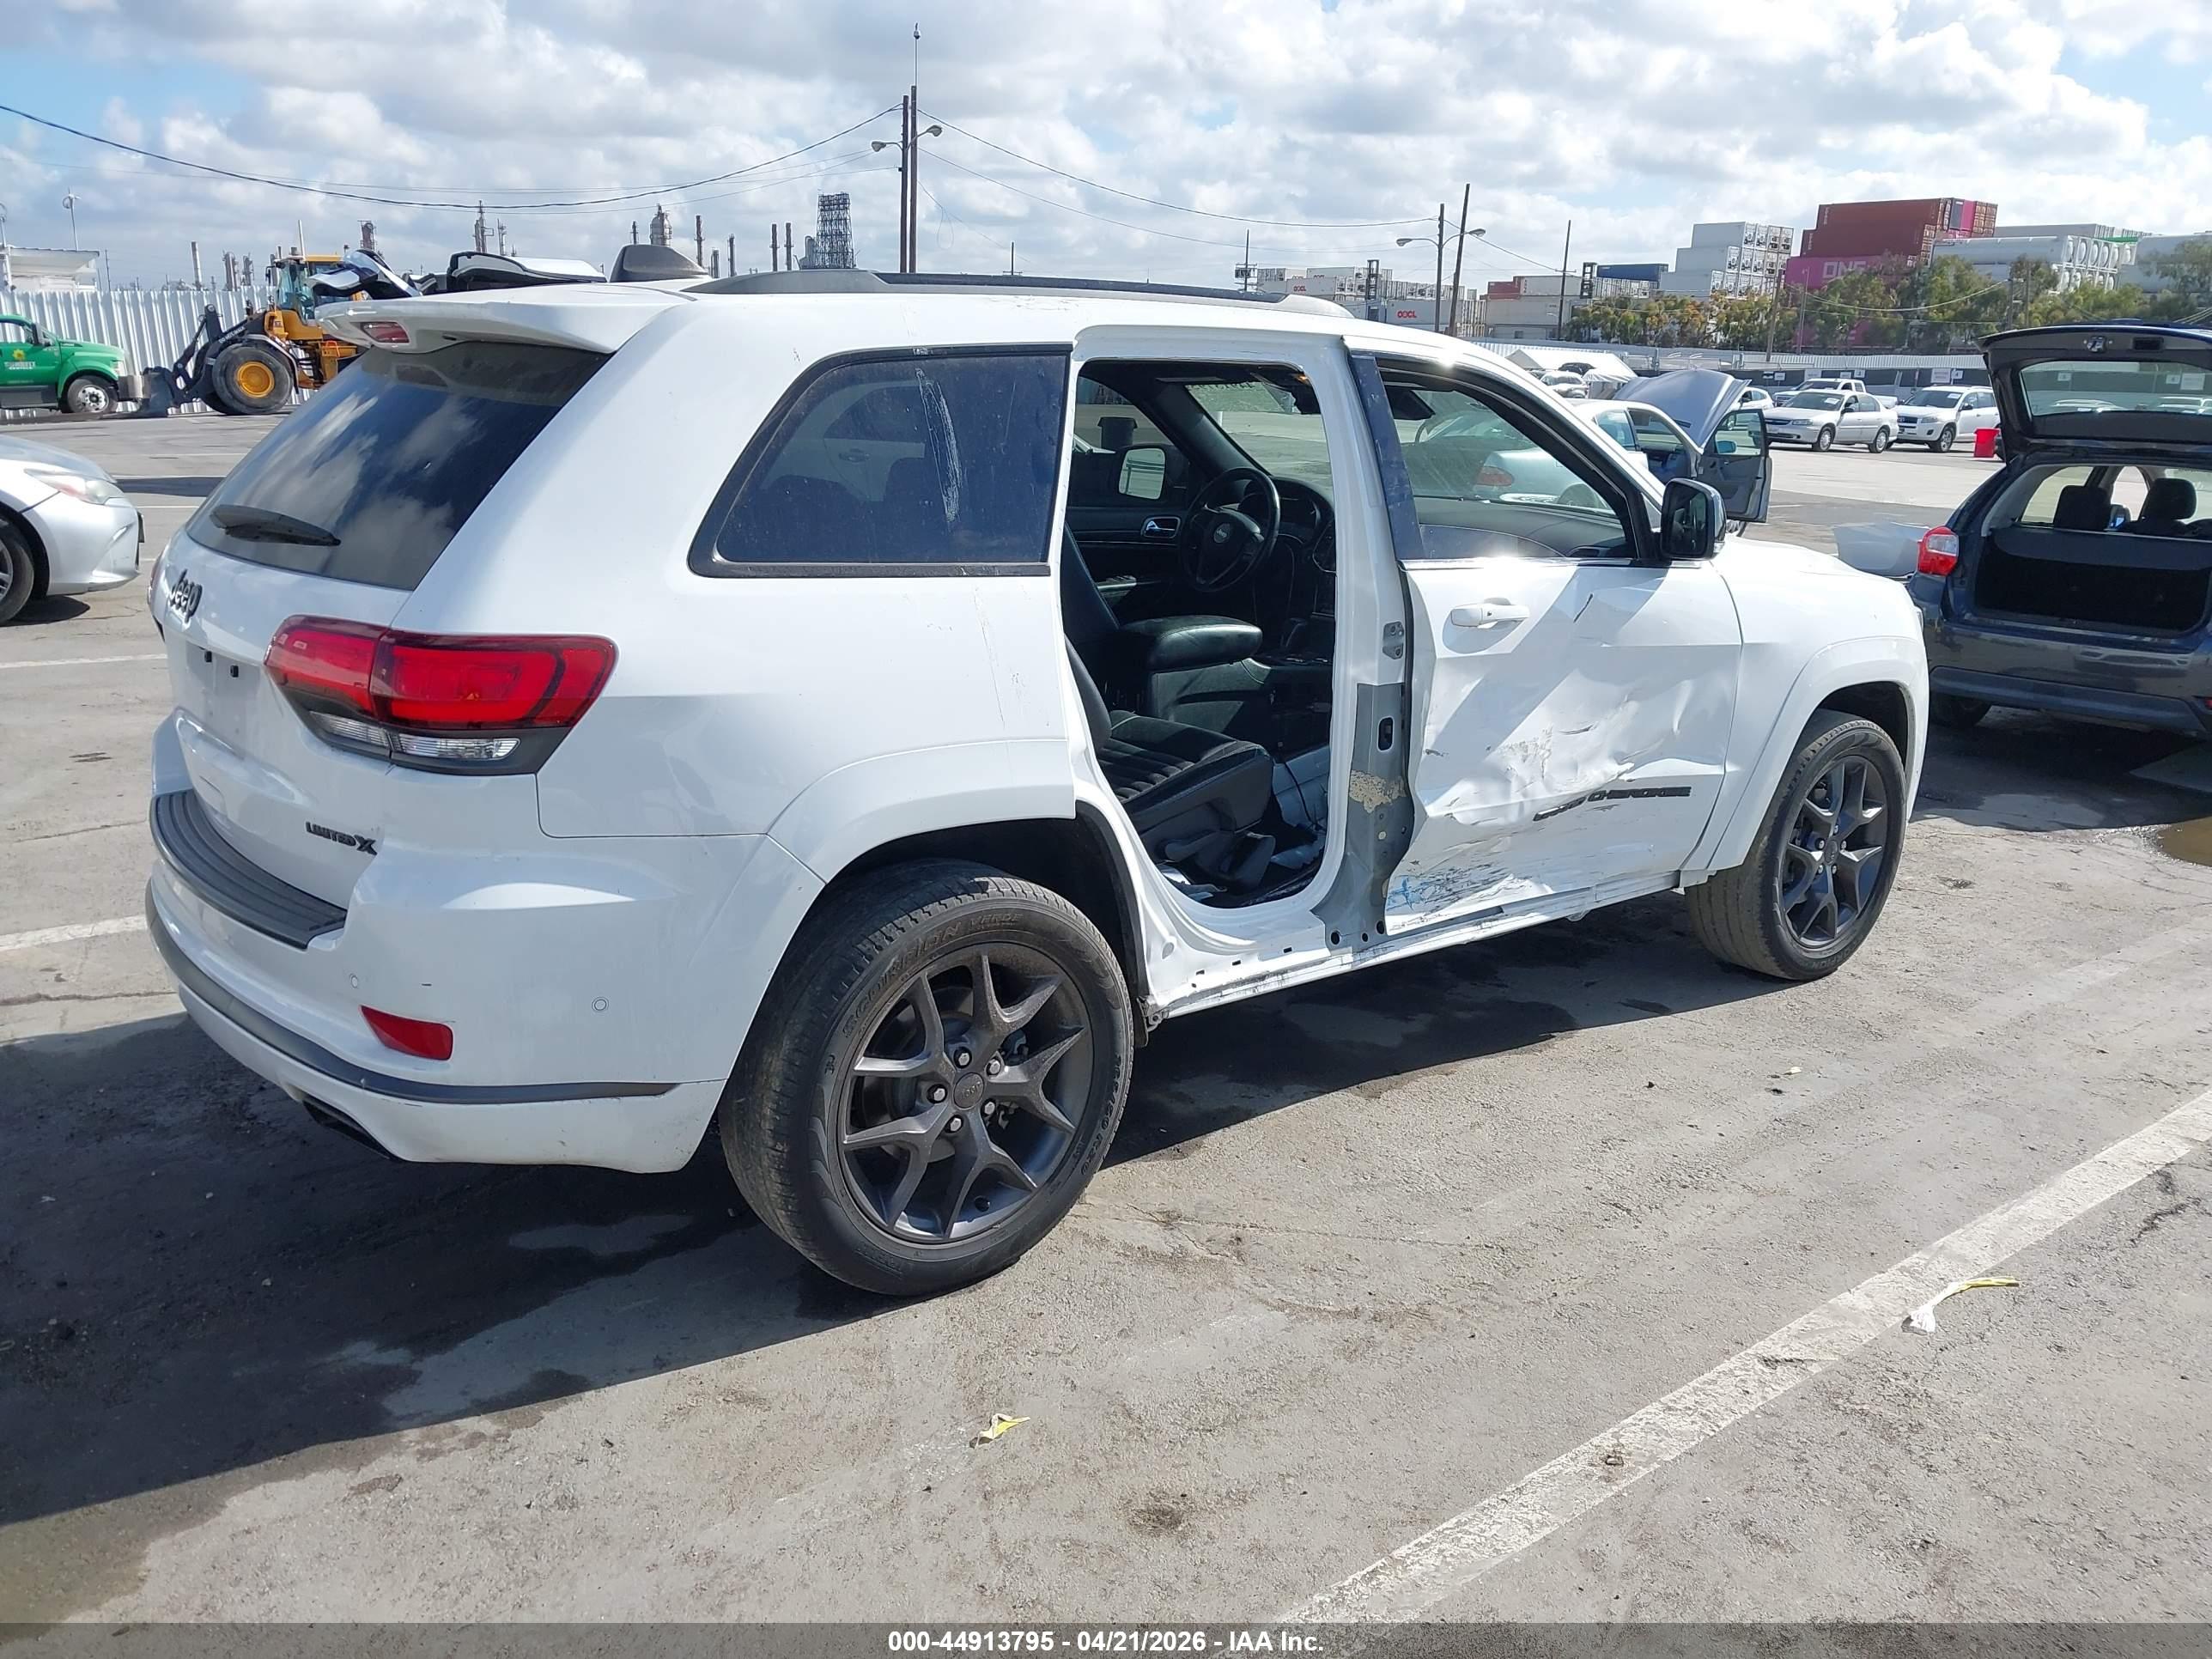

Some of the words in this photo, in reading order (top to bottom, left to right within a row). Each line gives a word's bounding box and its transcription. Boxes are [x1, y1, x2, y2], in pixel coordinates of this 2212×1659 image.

[1397, 310, 1417, 319] OOCL
[170, 568, 203, 624] Jeep
[305, 821, 357, 847] LIMITED
